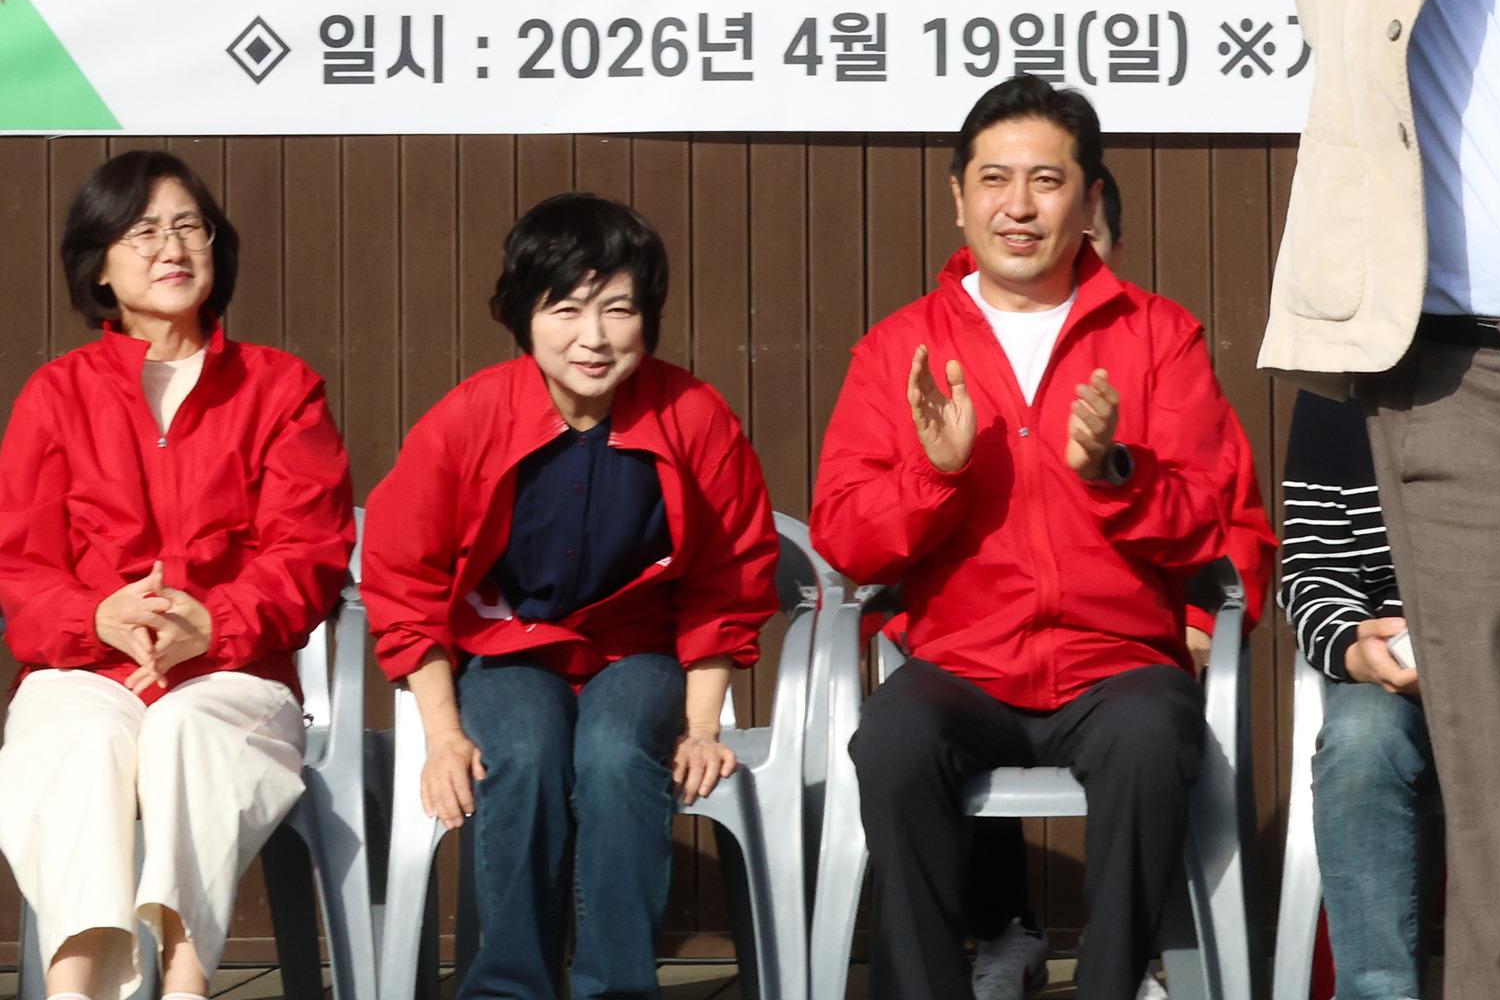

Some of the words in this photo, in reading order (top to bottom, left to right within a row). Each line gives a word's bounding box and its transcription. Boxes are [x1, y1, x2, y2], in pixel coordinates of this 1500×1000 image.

[319, 14, 444, 85] 일시
[518, 12, 754, 82] 2026년
[783, 12, 887, 82] 4월
[923, 10, 1188, 87] 19일(일)
